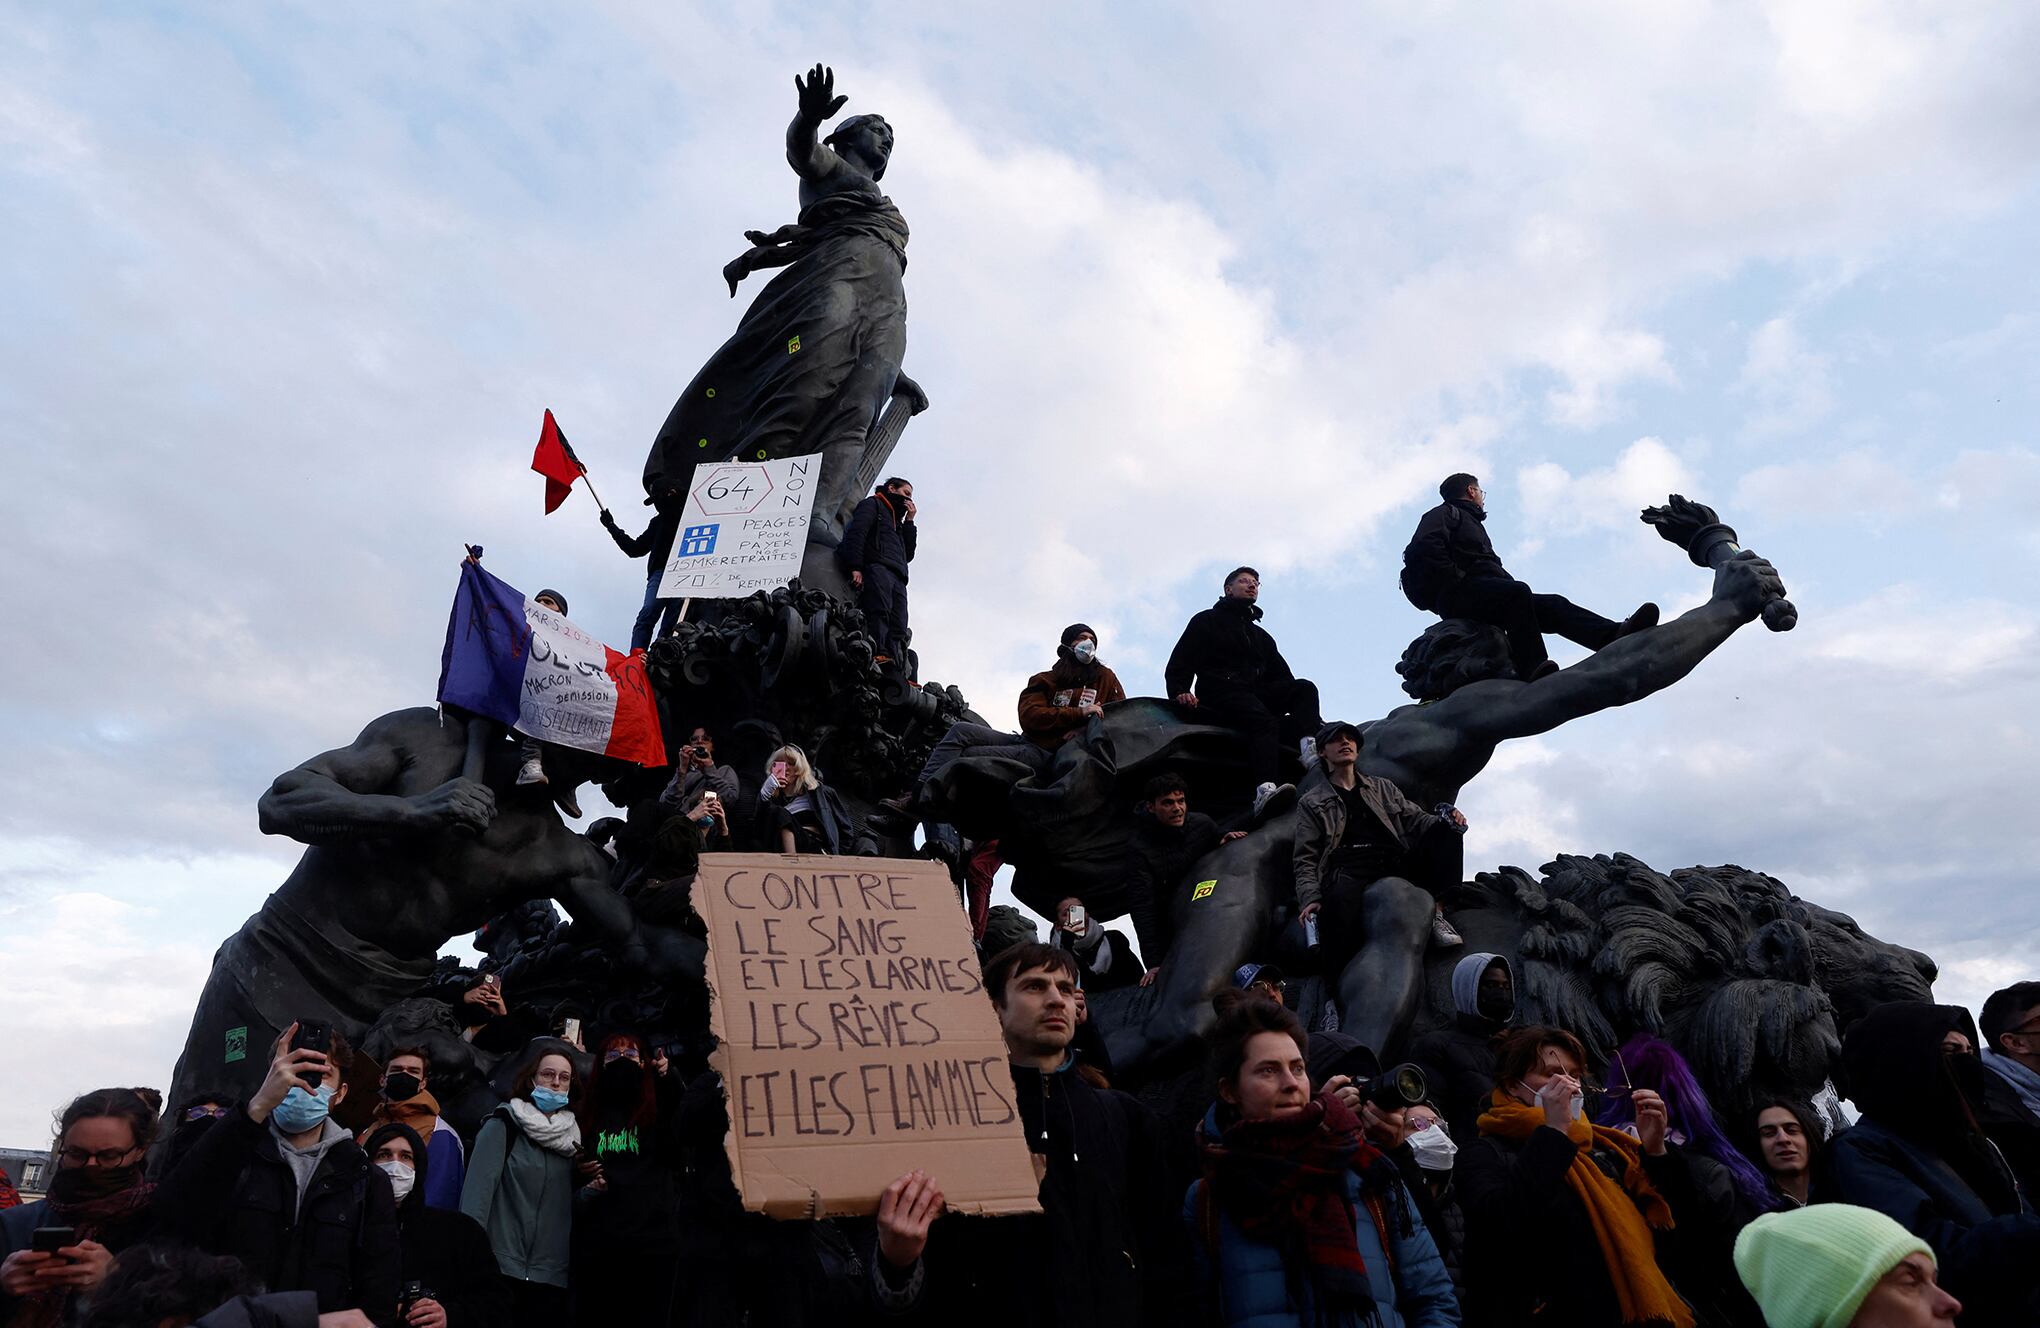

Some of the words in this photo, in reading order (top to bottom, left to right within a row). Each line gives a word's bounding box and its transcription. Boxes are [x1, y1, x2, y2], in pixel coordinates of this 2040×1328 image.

[707, 476, 753, 501] 64
[782, 458, 808, 507] NON
[743, 516, 807, 530] PEAGES
[758, 531, 790, 539] POUR
[720, 553, 798, 566] RETRAITES
[739, 540, 793, 550] PAYER
[525, 674, 572, 696] MACRON
[724, 871, 917, 911] CONTRE
[735, 918, 788, 956] LE
[807, 915, 906, 957] SANG
[741, 959, 789, 990] ET
[800, 959, 861, 990] LES
[865, 956, 983, 995] LARMES
[749, 1001, 823, 1051] LES
[829, 994, 941, 1051] RÊVES
[741, 1071, 780, 1137] ET
[791, 1069, 855, 1136] LES
[860, 1056, 1016, 1136] FLAMMES
